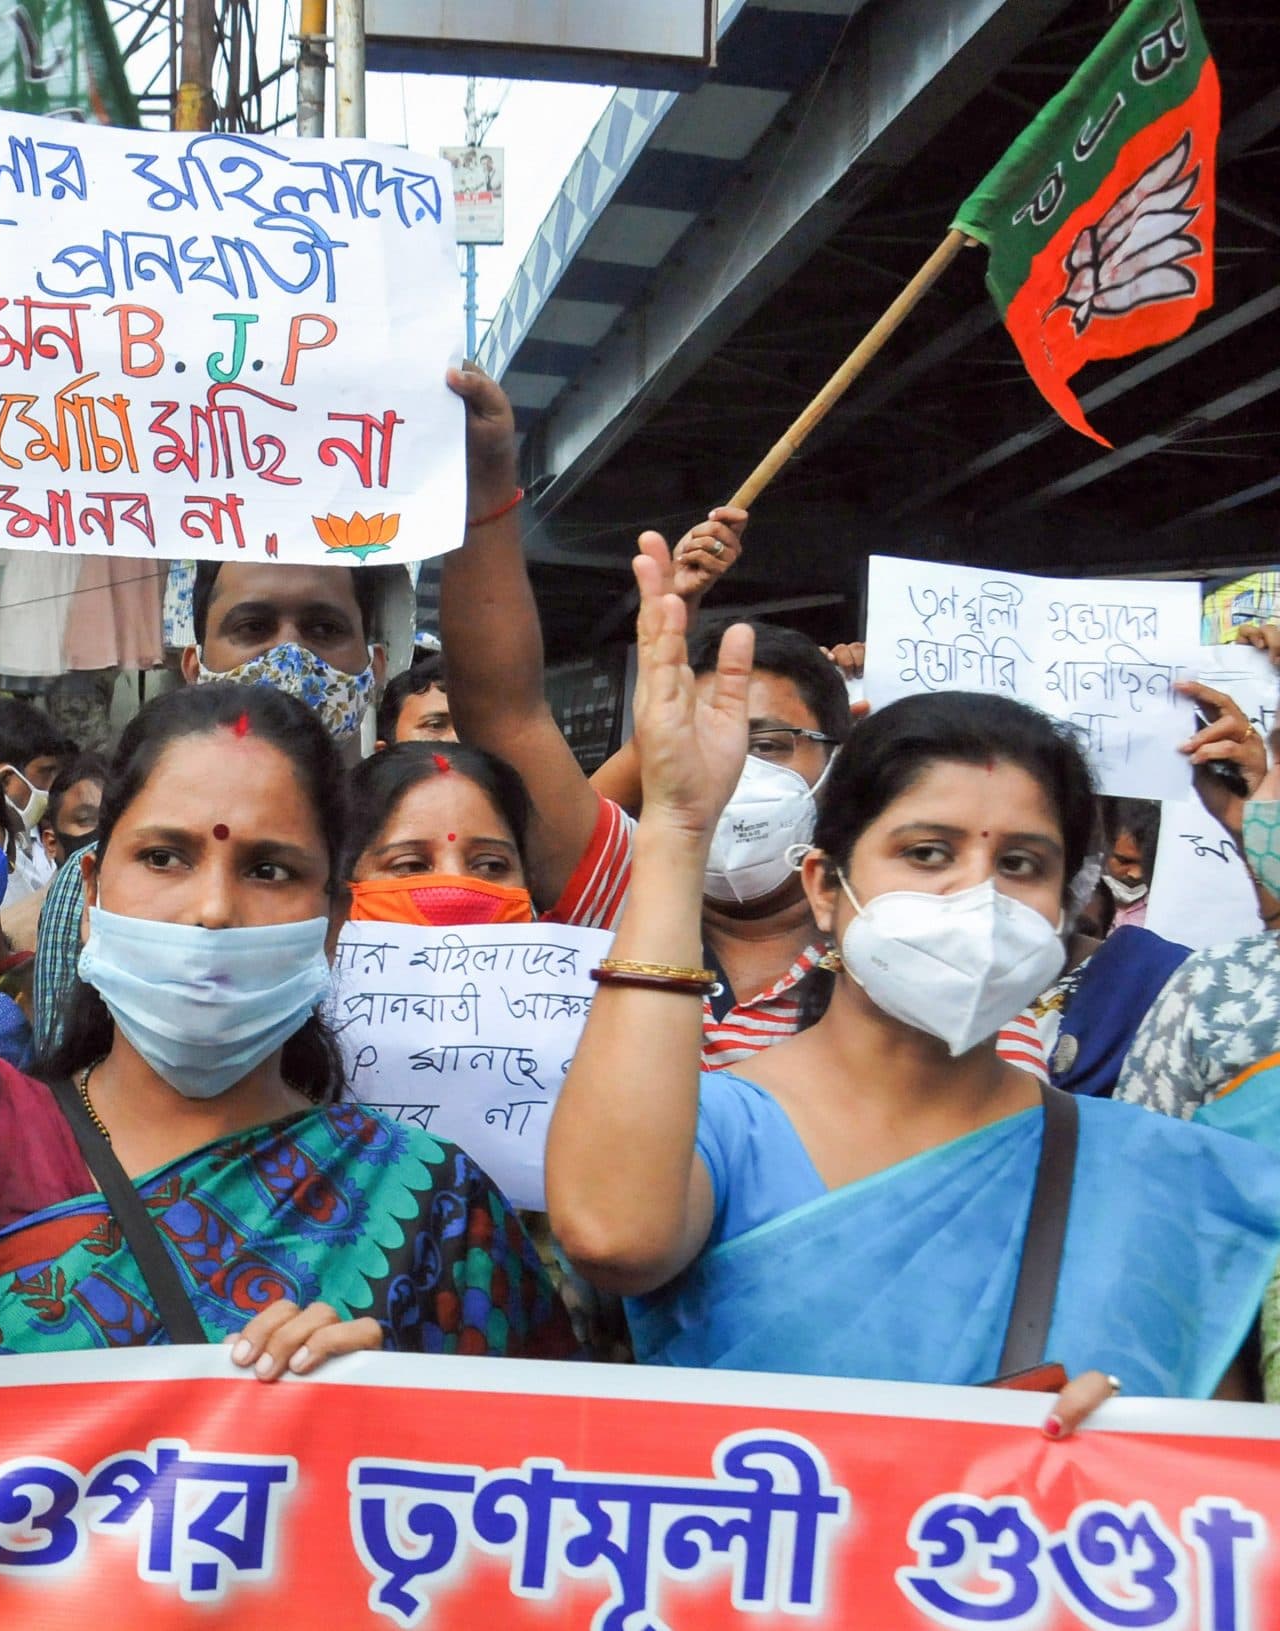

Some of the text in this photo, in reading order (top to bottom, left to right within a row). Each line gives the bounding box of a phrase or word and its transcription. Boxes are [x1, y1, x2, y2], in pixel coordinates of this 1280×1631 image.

[125, 133, 442, 228] মহিলাদের
[318, 410, 405, 488] না
[357, 1437, 841, 1631] তৃণমূলী
